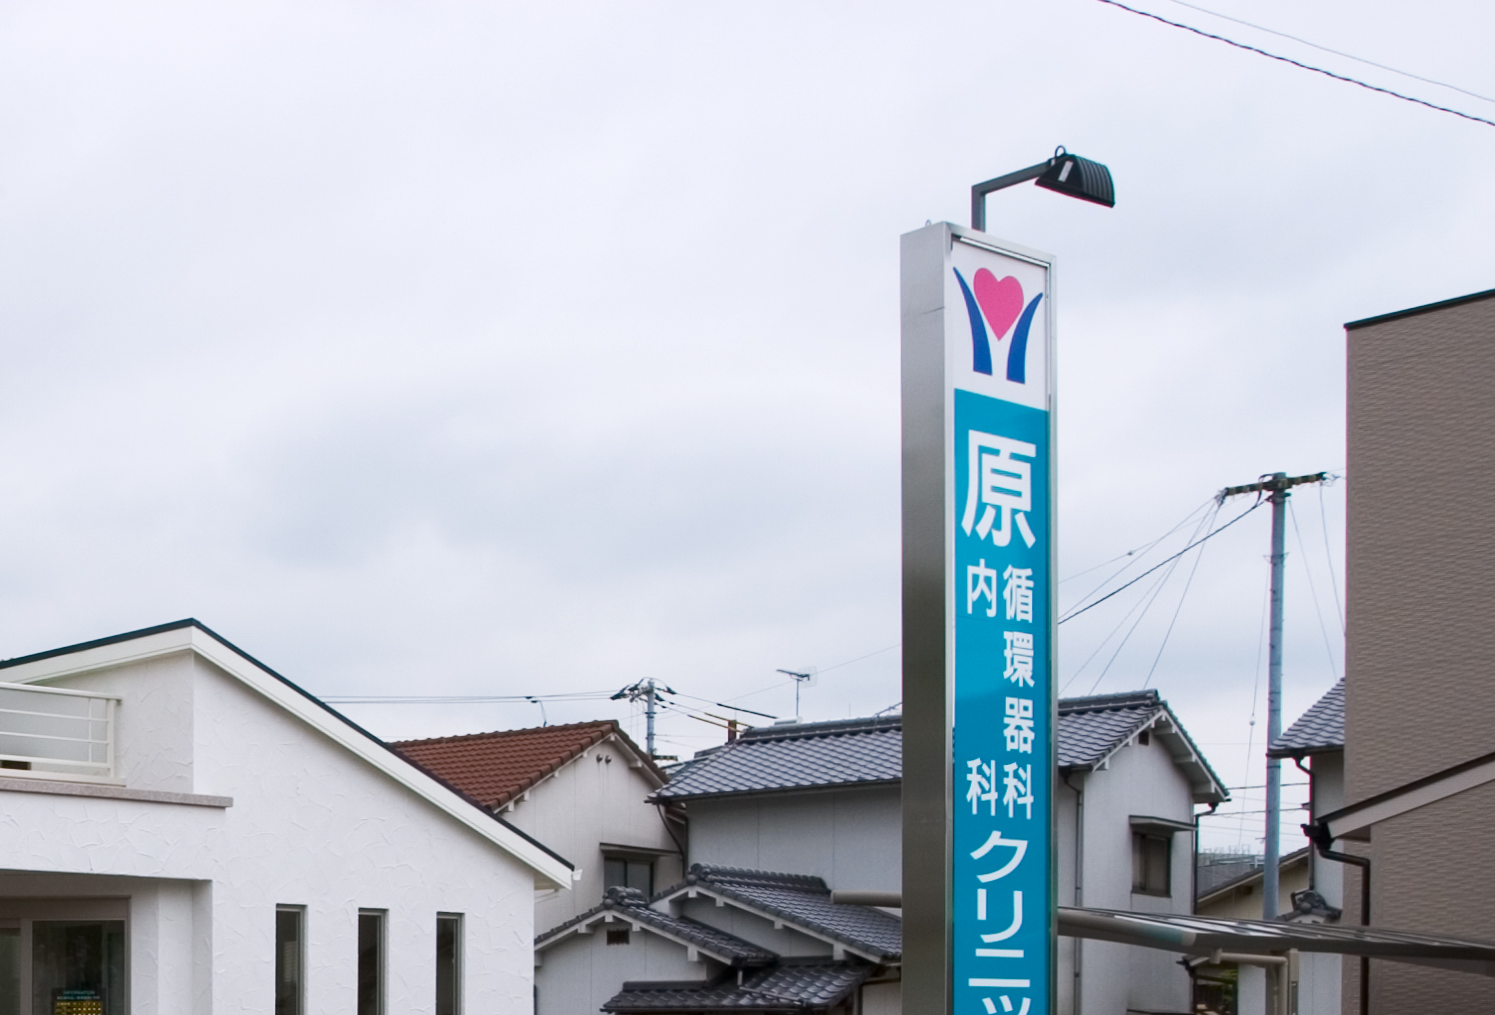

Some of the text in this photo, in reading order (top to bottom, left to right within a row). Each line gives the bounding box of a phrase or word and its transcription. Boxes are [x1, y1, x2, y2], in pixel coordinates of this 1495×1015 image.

[961, 429, 1037, 549] 原
[1003, 564, 1035, 820] 循環器科
